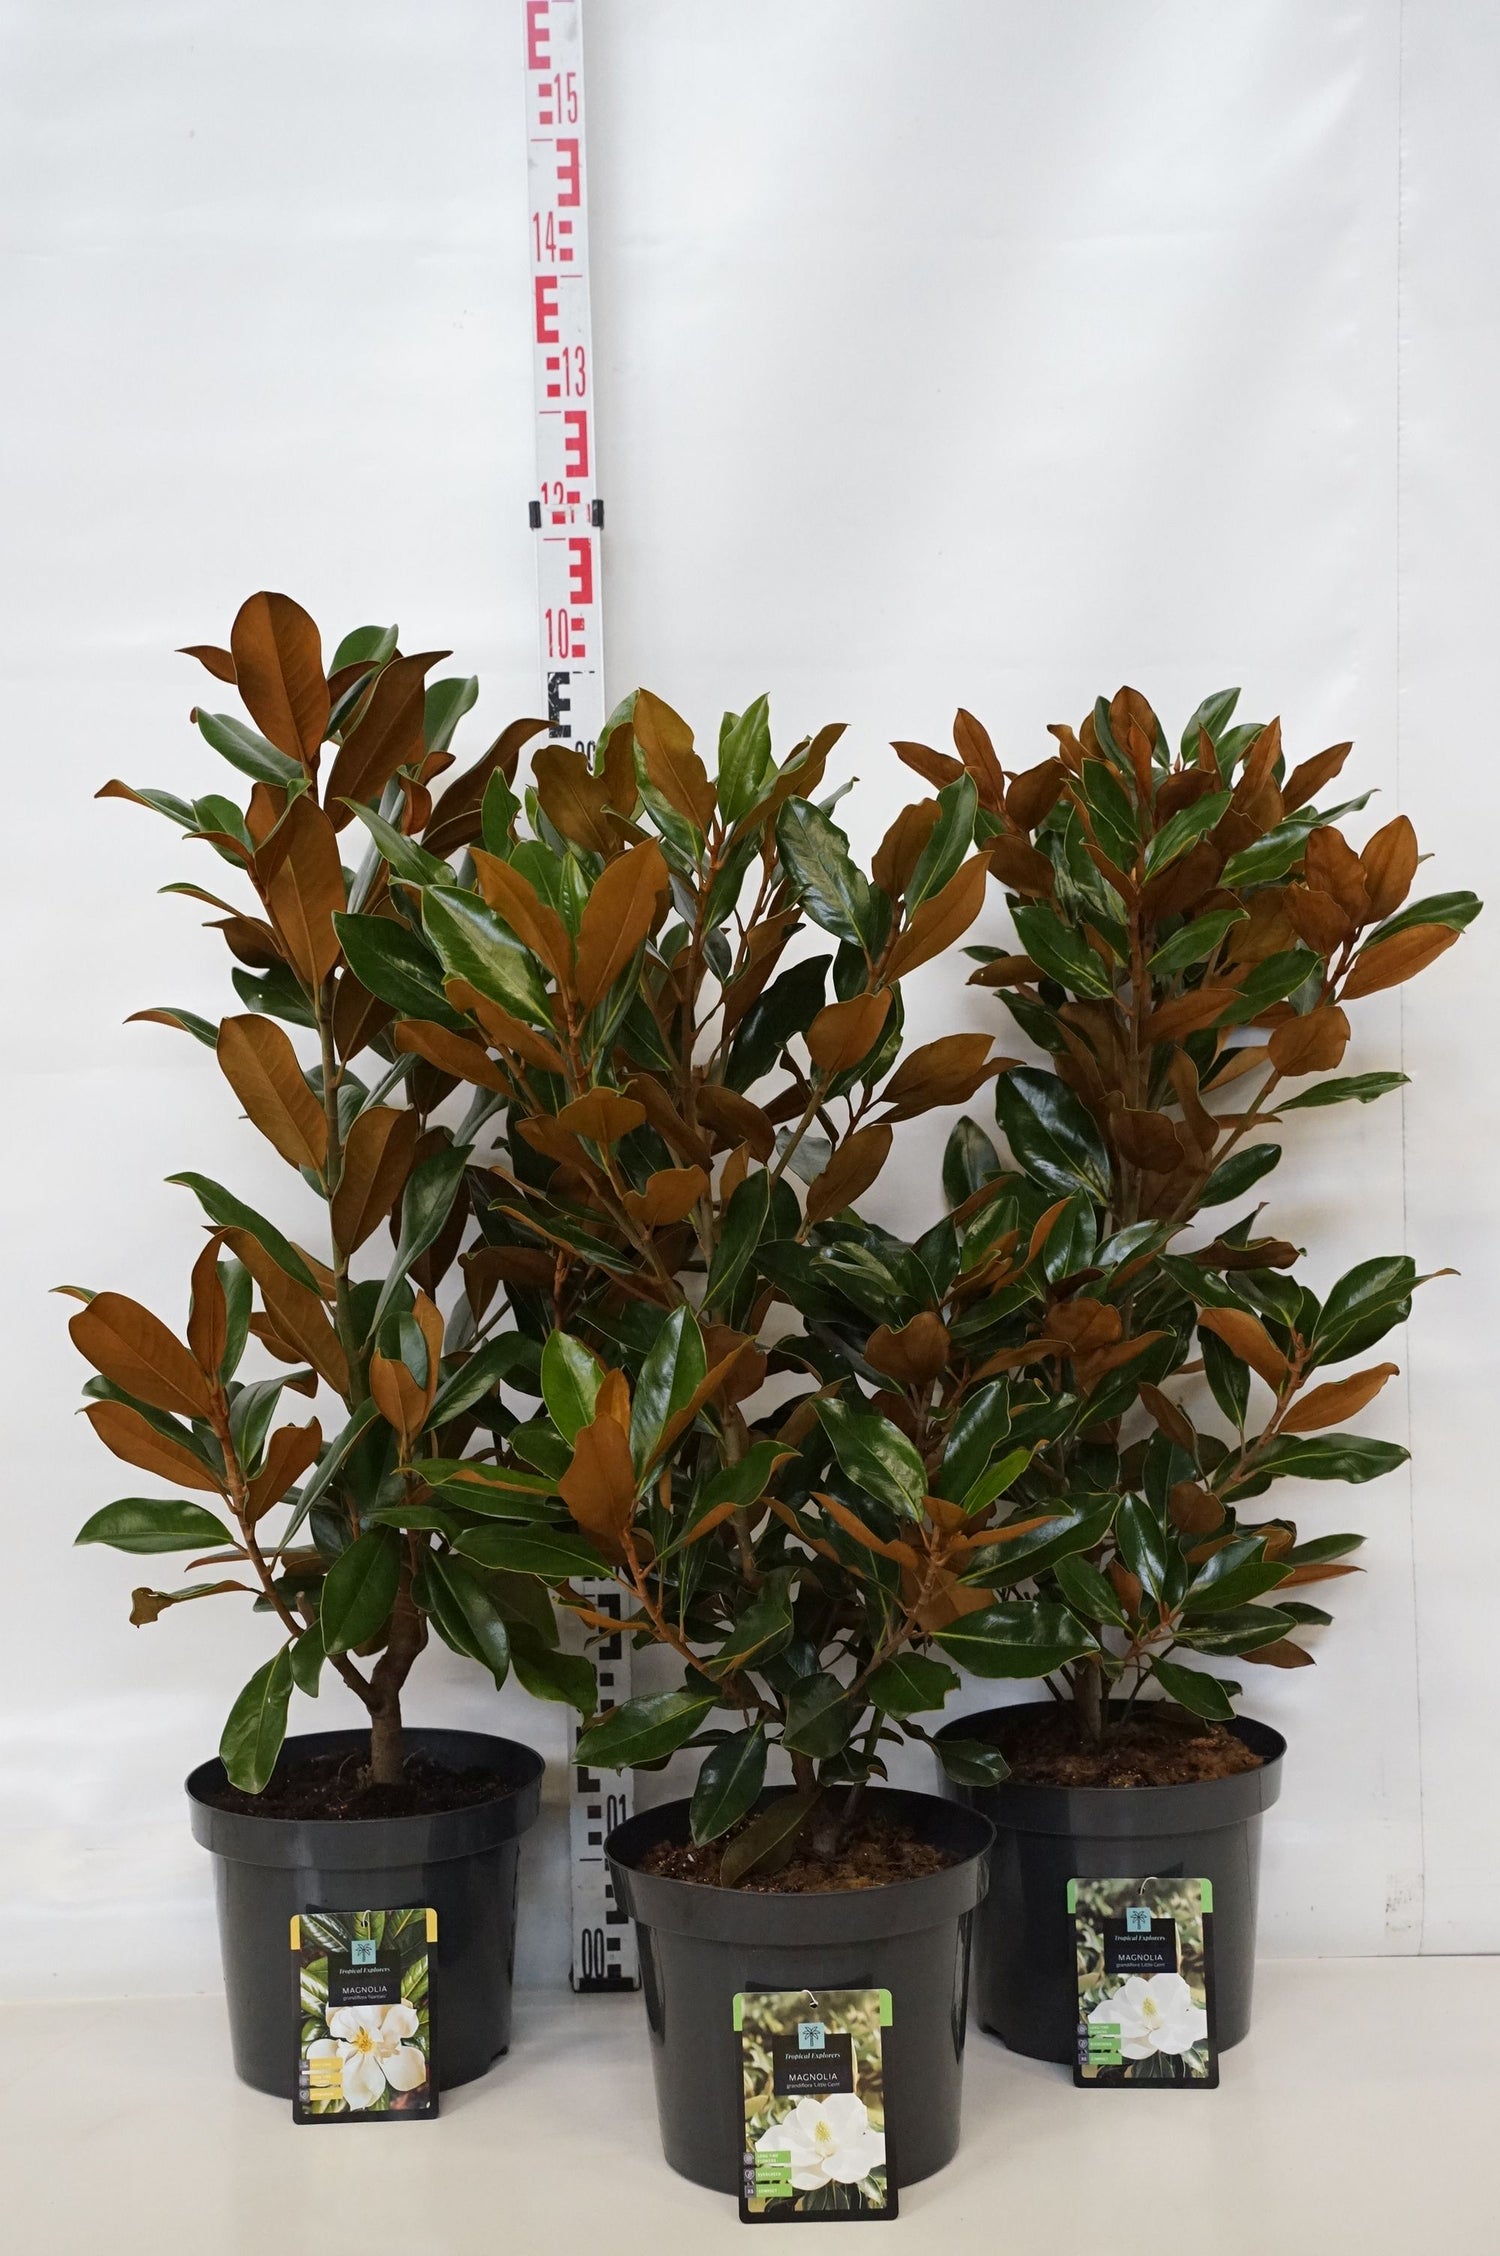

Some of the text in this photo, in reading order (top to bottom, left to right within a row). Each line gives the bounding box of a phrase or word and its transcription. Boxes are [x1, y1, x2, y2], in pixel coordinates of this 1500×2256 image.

[553, 72, 578, 124] 15
[532, 211, 557, 263] 14
[562, 346, 587, 397] 13
[545, 608, 569, 660] 10
[581, 1928, 604, 1979] 00
[342, 1985, 388, 1994] MAGNOLIA
[788, 2072, 838, 2081] MAGNOLIA
